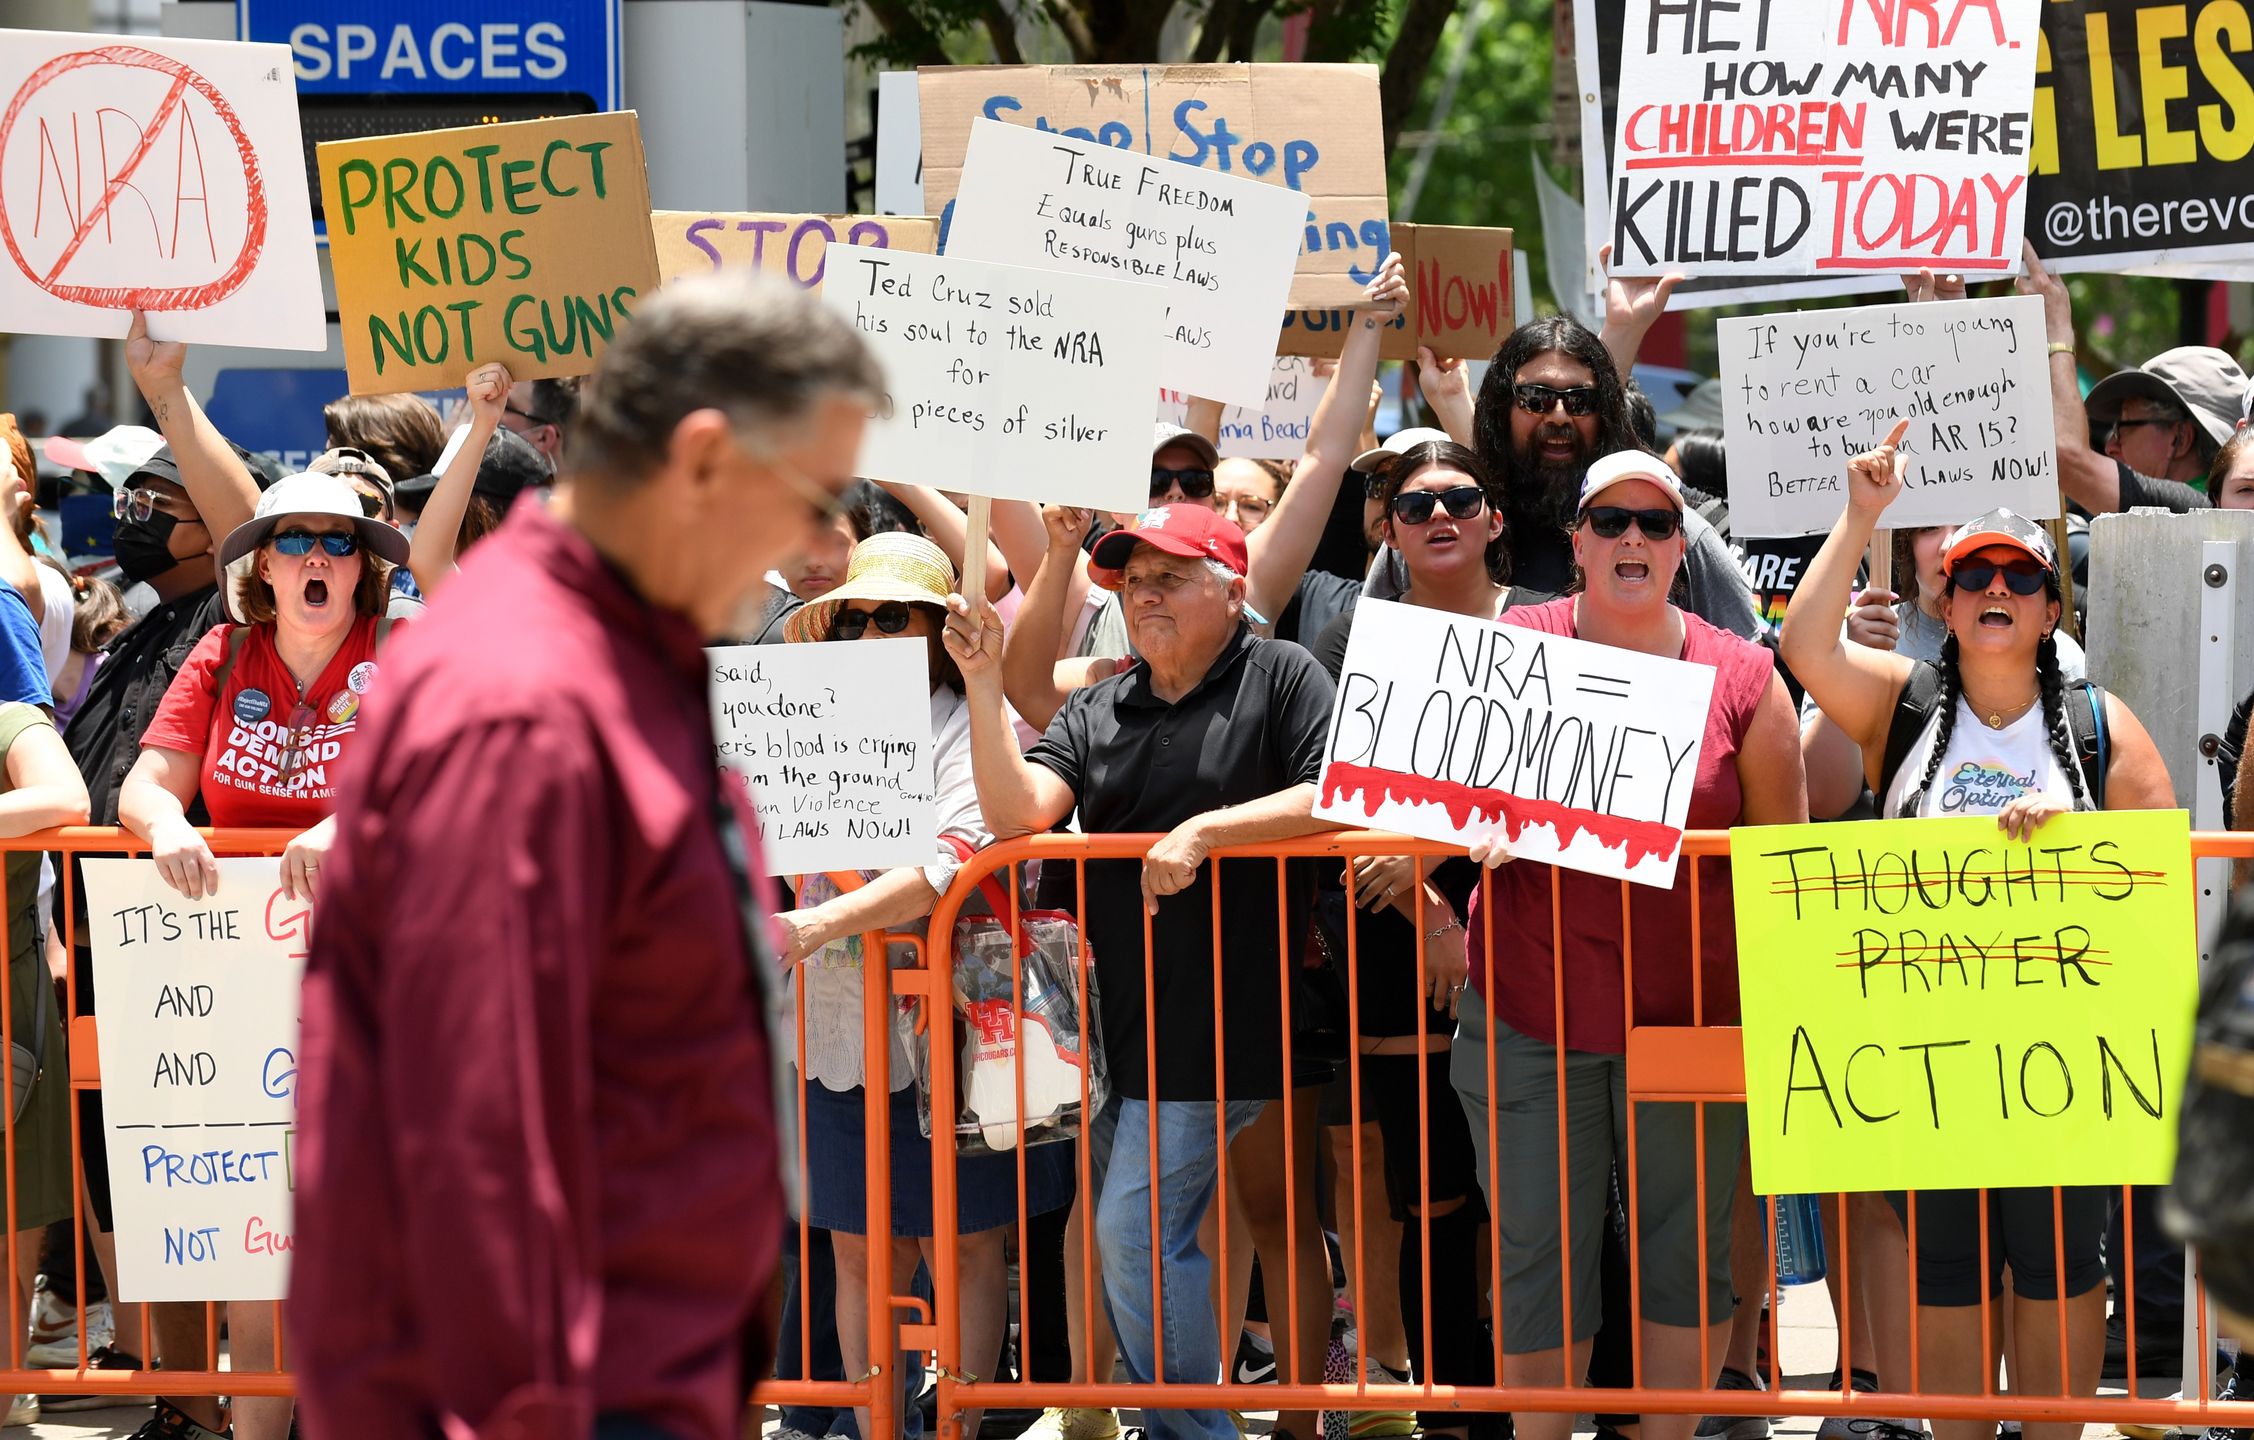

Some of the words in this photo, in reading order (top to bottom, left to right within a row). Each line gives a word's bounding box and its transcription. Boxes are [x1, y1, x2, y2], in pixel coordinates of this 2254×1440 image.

[290, 23, 567, 81] SPACES
[1703, 60, 1823, 101] HOW
[1832, 60, 1988, 99] MANY
[1625, 101, 1867, 156] CHILDREN
[1889, 109, 2028, 155] WERE
[34, 98, 216, 263] NRA
[338, 139, 613, 235] PROTECT
[1053, 146, 1121, 190] TRUE
[1137, 166, 1234, 217] FREEDOM
[1036, 193, 1112, 230] Equals
[1126, 222, 1167, 249] guns
[1176, 225, 1217, 260] plus
[1612, 176, 1811, 266] KILLED
[1822, 172, 2025, 258] TODAY
[396, 228, 532, 288] KIDS
[1045, 229, 1165, 277] RESPONSIBLE
[1173, 261, 1219, 291] LAWS
[859, 259, 912, 297] Ted
[932, 274, 992, 309] Cruz
[1009, 289, 1055, 319] sold
[368, 300, 482, 375] NOT
[502, 286, 638, 363] GUNS
[856, 300, 888, 333] his
[904, 320, 951, 343] soul
[966, 320, 988, 346] to
[1006, 325, 1043, 350] the
[1054, 331, 1104, 367] NRA
[1748, 325, 1777, 360] If
[1794, 323, 1876, 369] you're
[1887, 313, 1925, 338] too
[1944, 317, 2018, 363] young
[946, 358, 990, 385] for
[1742, 373, 1769, 405] to
[1780, 367, 1841, 398] rent
[1856, 376, 1877, 394] a
[1891, 364, 1936, 390] car
[864, 392, 894, 420] 0
[912, 400, 985, 431] pieces
[1003, 404, 1028, 434] of
[1044, 414, 1108, 442] silver
[1747, 413, 1800, 435] how
[1807, 415, 1851, 433] are
[1858, 405, 1899, 435] you
[1908, 392, 1939, 419] old
[1942, 368, 2017, 411] enough
[1808, 436, 1832, 458] to
[1932, 422, 1968, 454] AR
[1979, 416, 2018, 447] 15?
[1769, 472, 1841, 497] BETTER
[1921, 466, 1974, 485] LAWS
[1992, 451, 2050, 482] NOW!
[1745, 553, 1801, 590] ARE
[715, 660, 772, 694] said,
[1436, 623, 1553, 706] NRA
[329, 691, 350, 713] DISARM
[337, 700, 352, 715] HATE
[722, 701, 765, 728] you
[767, 688, 836, 718] done?
[228, 727, 341, 770] DEMAND
[766, 729, 825, 758] blood
[834, 734, 849, 754] is
[859, 734, 916, 772] crying
[213, 770, 231, 786] FOR
[234, 778, 256, 792] GUN
[259, 785, 292, 799] SENSE
[296, 789, 308, 799] IN
[311, 787, 337, 799] AME
[780, 765, 823, 787] the
[829, 770, 904, 795] ground
[1952, 761, 2036, 788] Eternal
[793, 786, 883, 815] Violence
[1939, 785, 2025, 812] Optim
[779, 820, 830, 840] LAWS
[848, 818, 911, 839] NOW!
[1760, 840, 2135, 920] THOUGHTS
[113, 903, 182, 947] IT'S
[189, 910, 241, 940] THE
[1853, 925, 2101, 998] PRAYER
[154, 984, 214, 1018] AND
[154, 1052, 216, 1088] AND
[1782, 1024, 2163, 1136] ACTION
[142, 1145, 279, 1188] PROTECT
[164, 1226, 220, 1265] NOT
